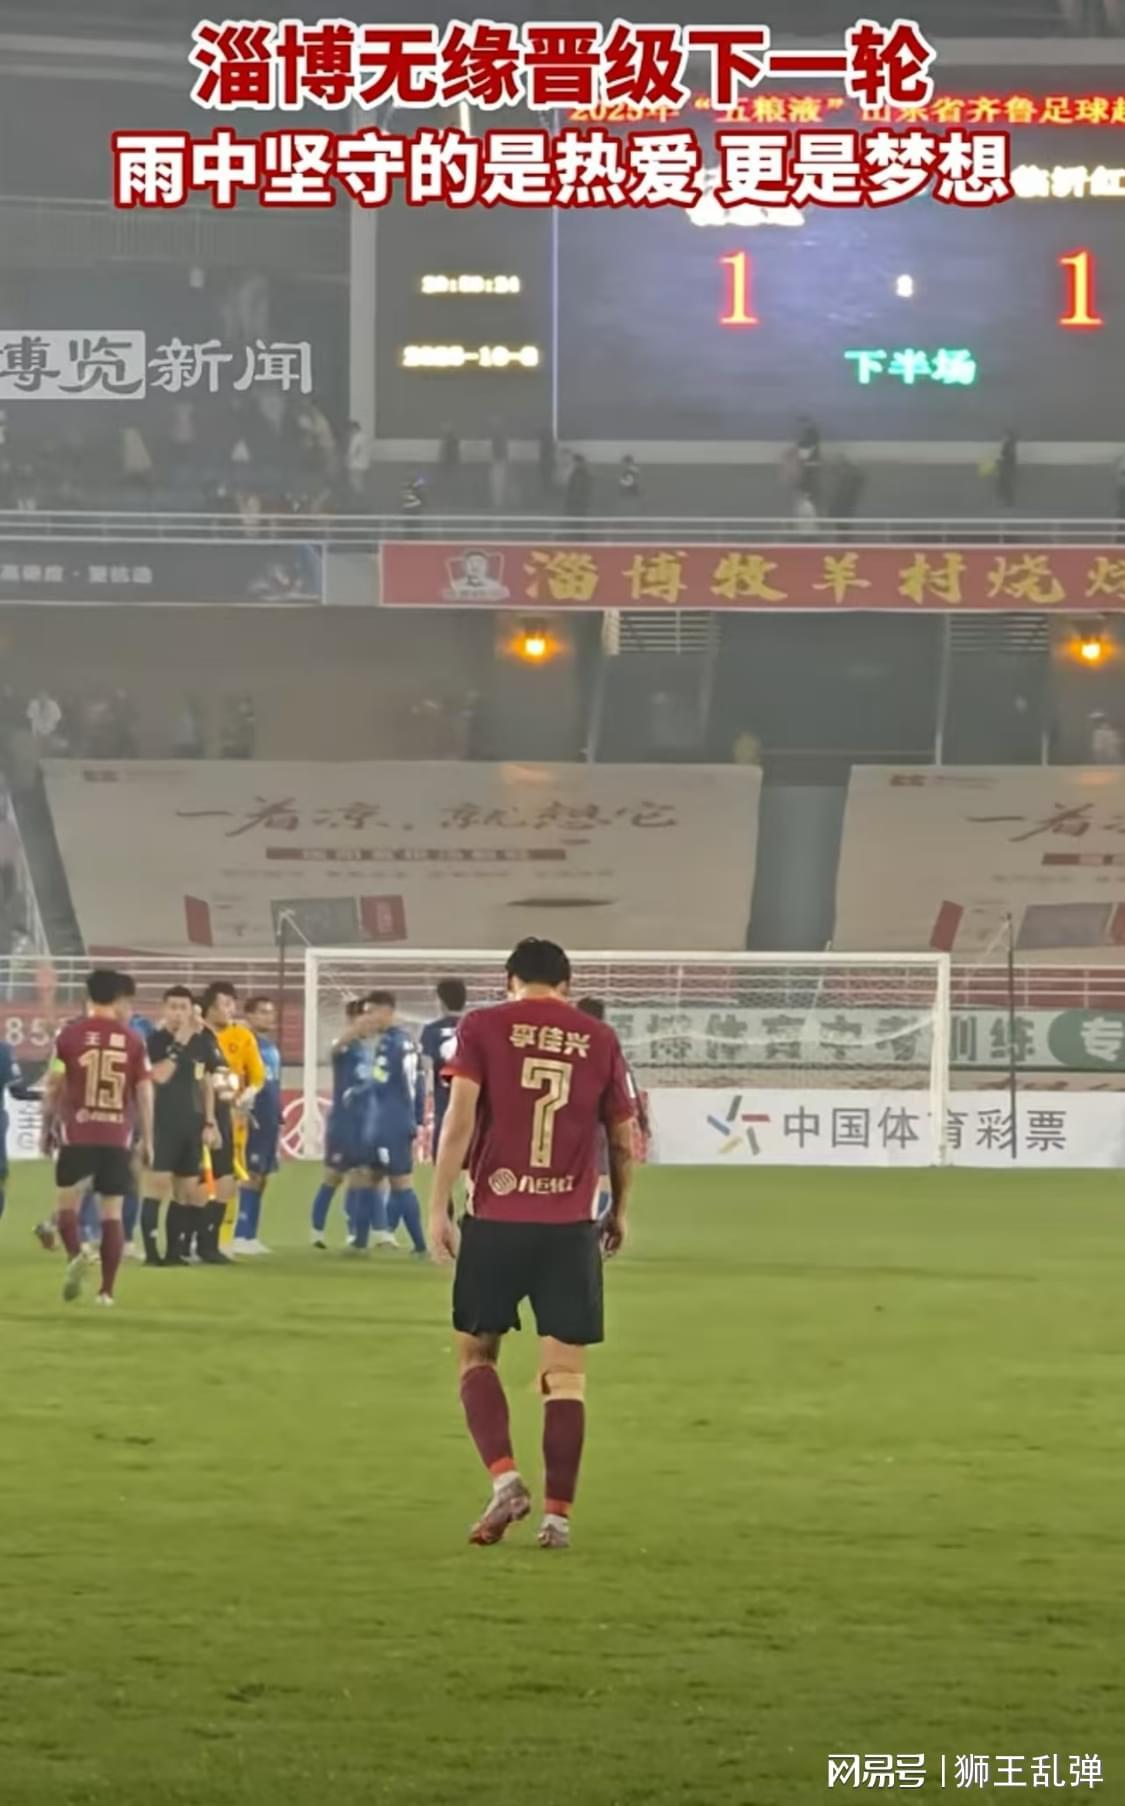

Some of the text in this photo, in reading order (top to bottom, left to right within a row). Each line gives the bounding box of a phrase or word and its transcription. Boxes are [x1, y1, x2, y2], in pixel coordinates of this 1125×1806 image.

[718, 251, 758, 325] 1
[1058, 251, 1103, 325] 1
[843, 348, 976, 385] 下半场
[78, 1048, 128, 1109] 15
[521, 1057, 573, 1168] 7
